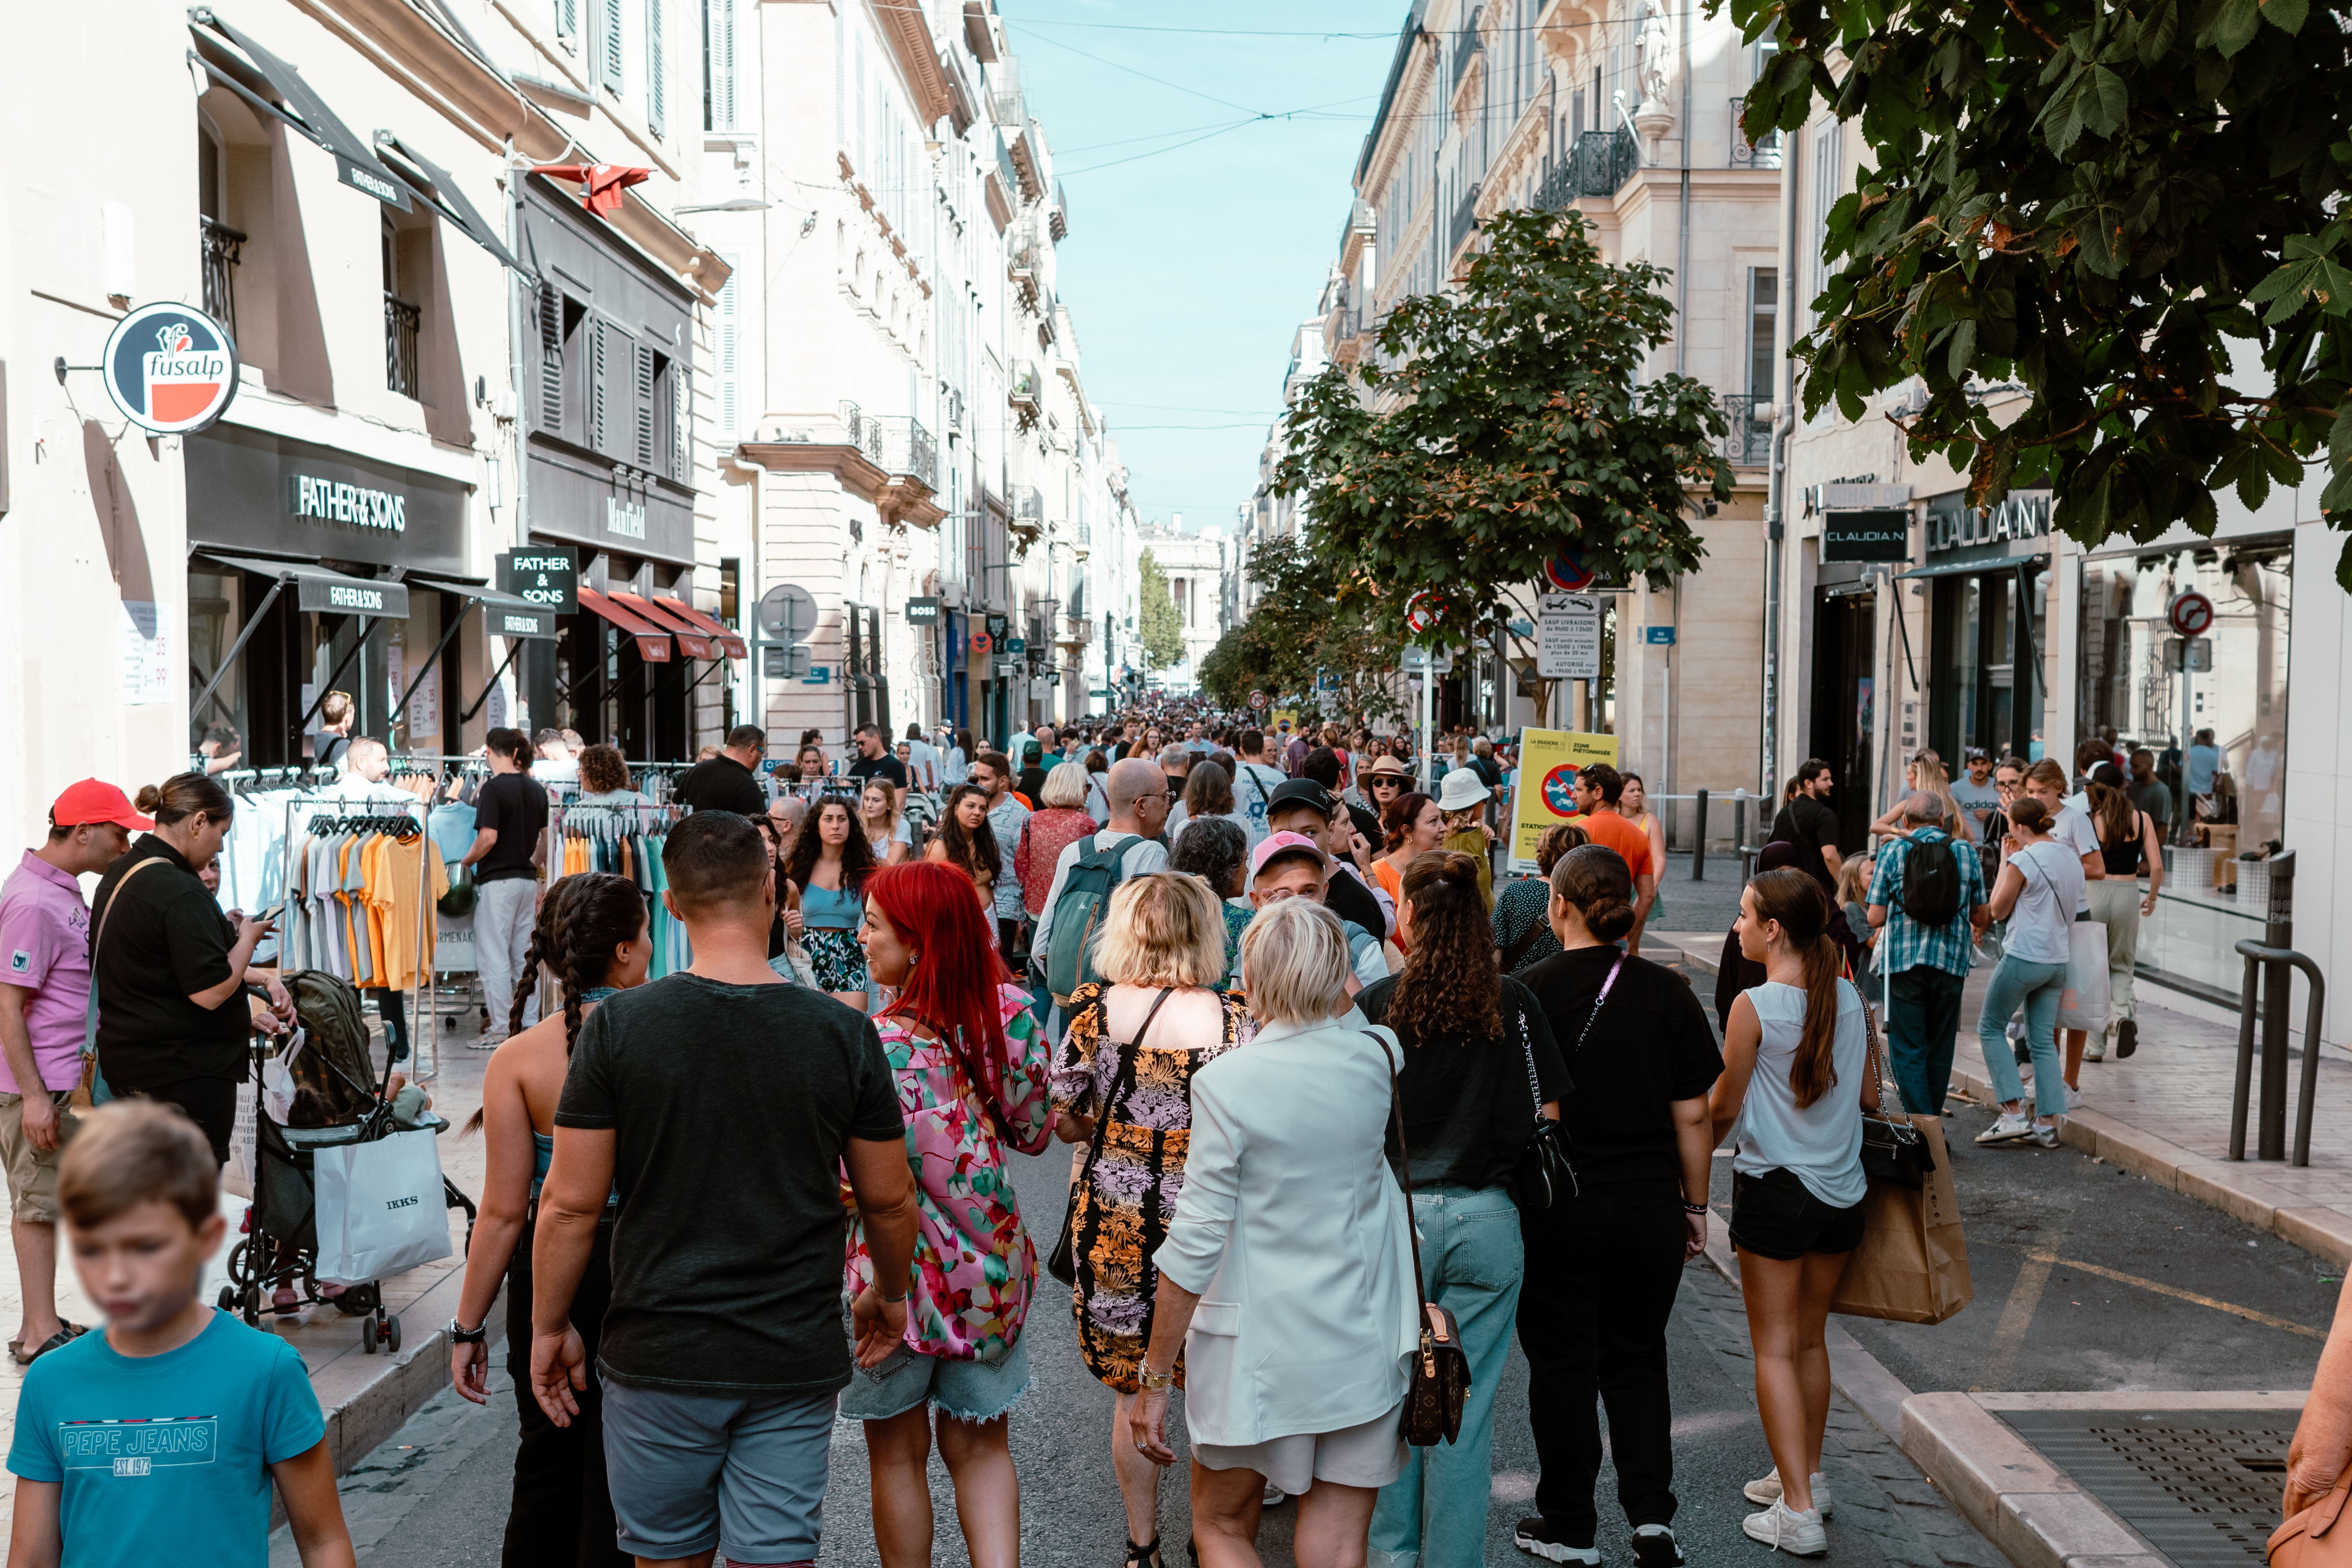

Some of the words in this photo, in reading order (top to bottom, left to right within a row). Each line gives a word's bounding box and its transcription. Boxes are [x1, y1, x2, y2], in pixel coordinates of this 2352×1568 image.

[151, 354, 223, 380] fusalp
[1827, 487, 1876, 503] ACHAT
[1883, 486, 1905, 503] OR
[606, 496, 645, 540] Manfield
[1827, 531, 1904, 541] CLAUDIA.N
[514, 557, 570, 570] FATHER
[537, 573, 548, 586] &
[523, 590, 564, 603] SONS
[911, 607, 936, 615] BOSS
[1964, 800, 1998, 808] adidas
[386, 1196, 418, 1210] IKKS
[64, 1430, 121, 1456] PEPE
[127, 1427, 208, 1454] JEANS
[115, 1459, 131, 1475] EST.
[133, 1458, 150, 1474] 1973
